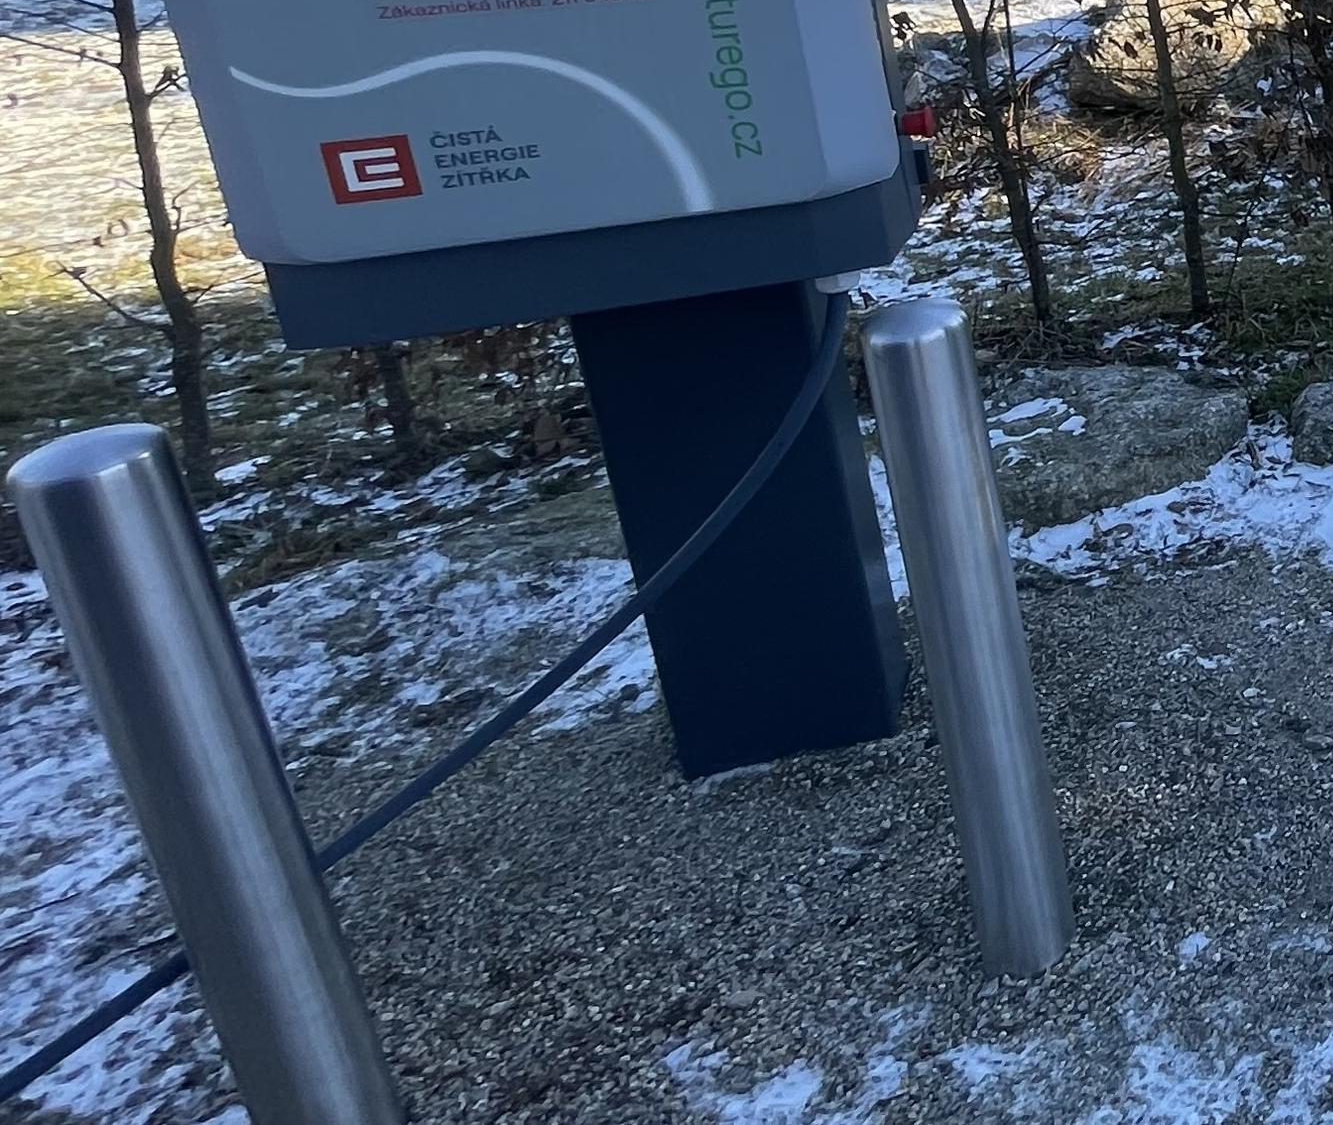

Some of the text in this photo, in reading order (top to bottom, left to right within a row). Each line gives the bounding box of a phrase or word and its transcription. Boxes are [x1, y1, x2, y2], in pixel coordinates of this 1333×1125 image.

[429, 125, 504, 149] ČISTÁ
[434, 144, 542, 170] ENERGIE
[440, 166, 532, 190] ZÍTŘKA
